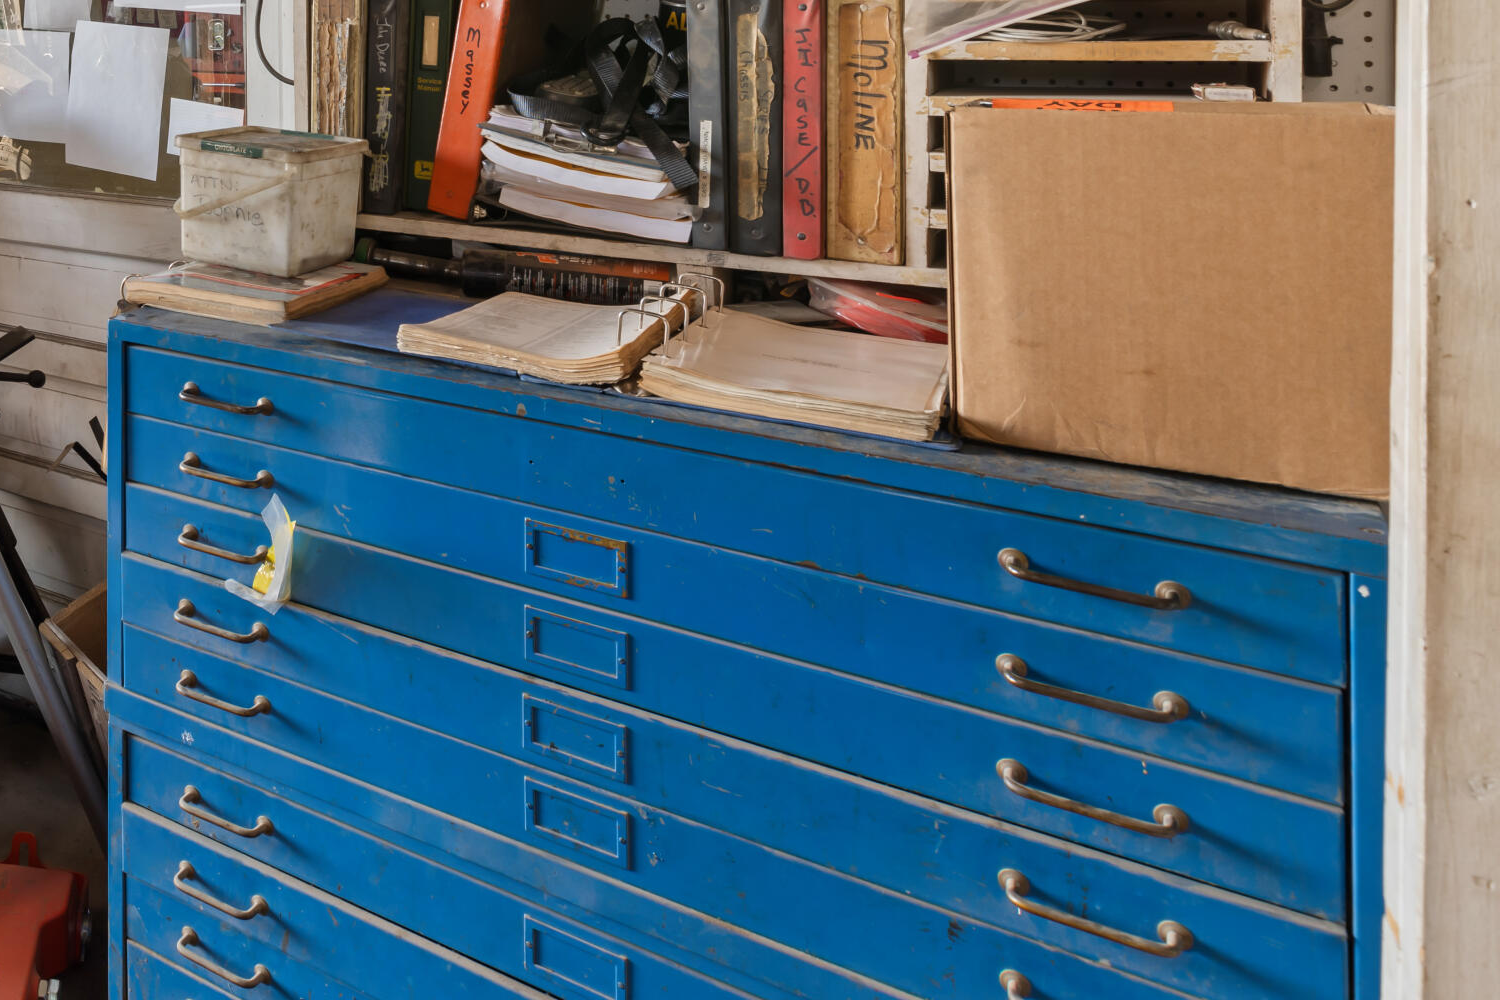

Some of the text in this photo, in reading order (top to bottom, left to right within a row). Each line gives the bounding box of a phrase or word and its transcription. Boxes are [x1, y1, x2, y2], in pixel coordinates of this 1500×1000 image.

[460, 27, 481, 115] Massey
[417, 77, 442, 85] Service
[1050, 101, 1122, 109] DAY
